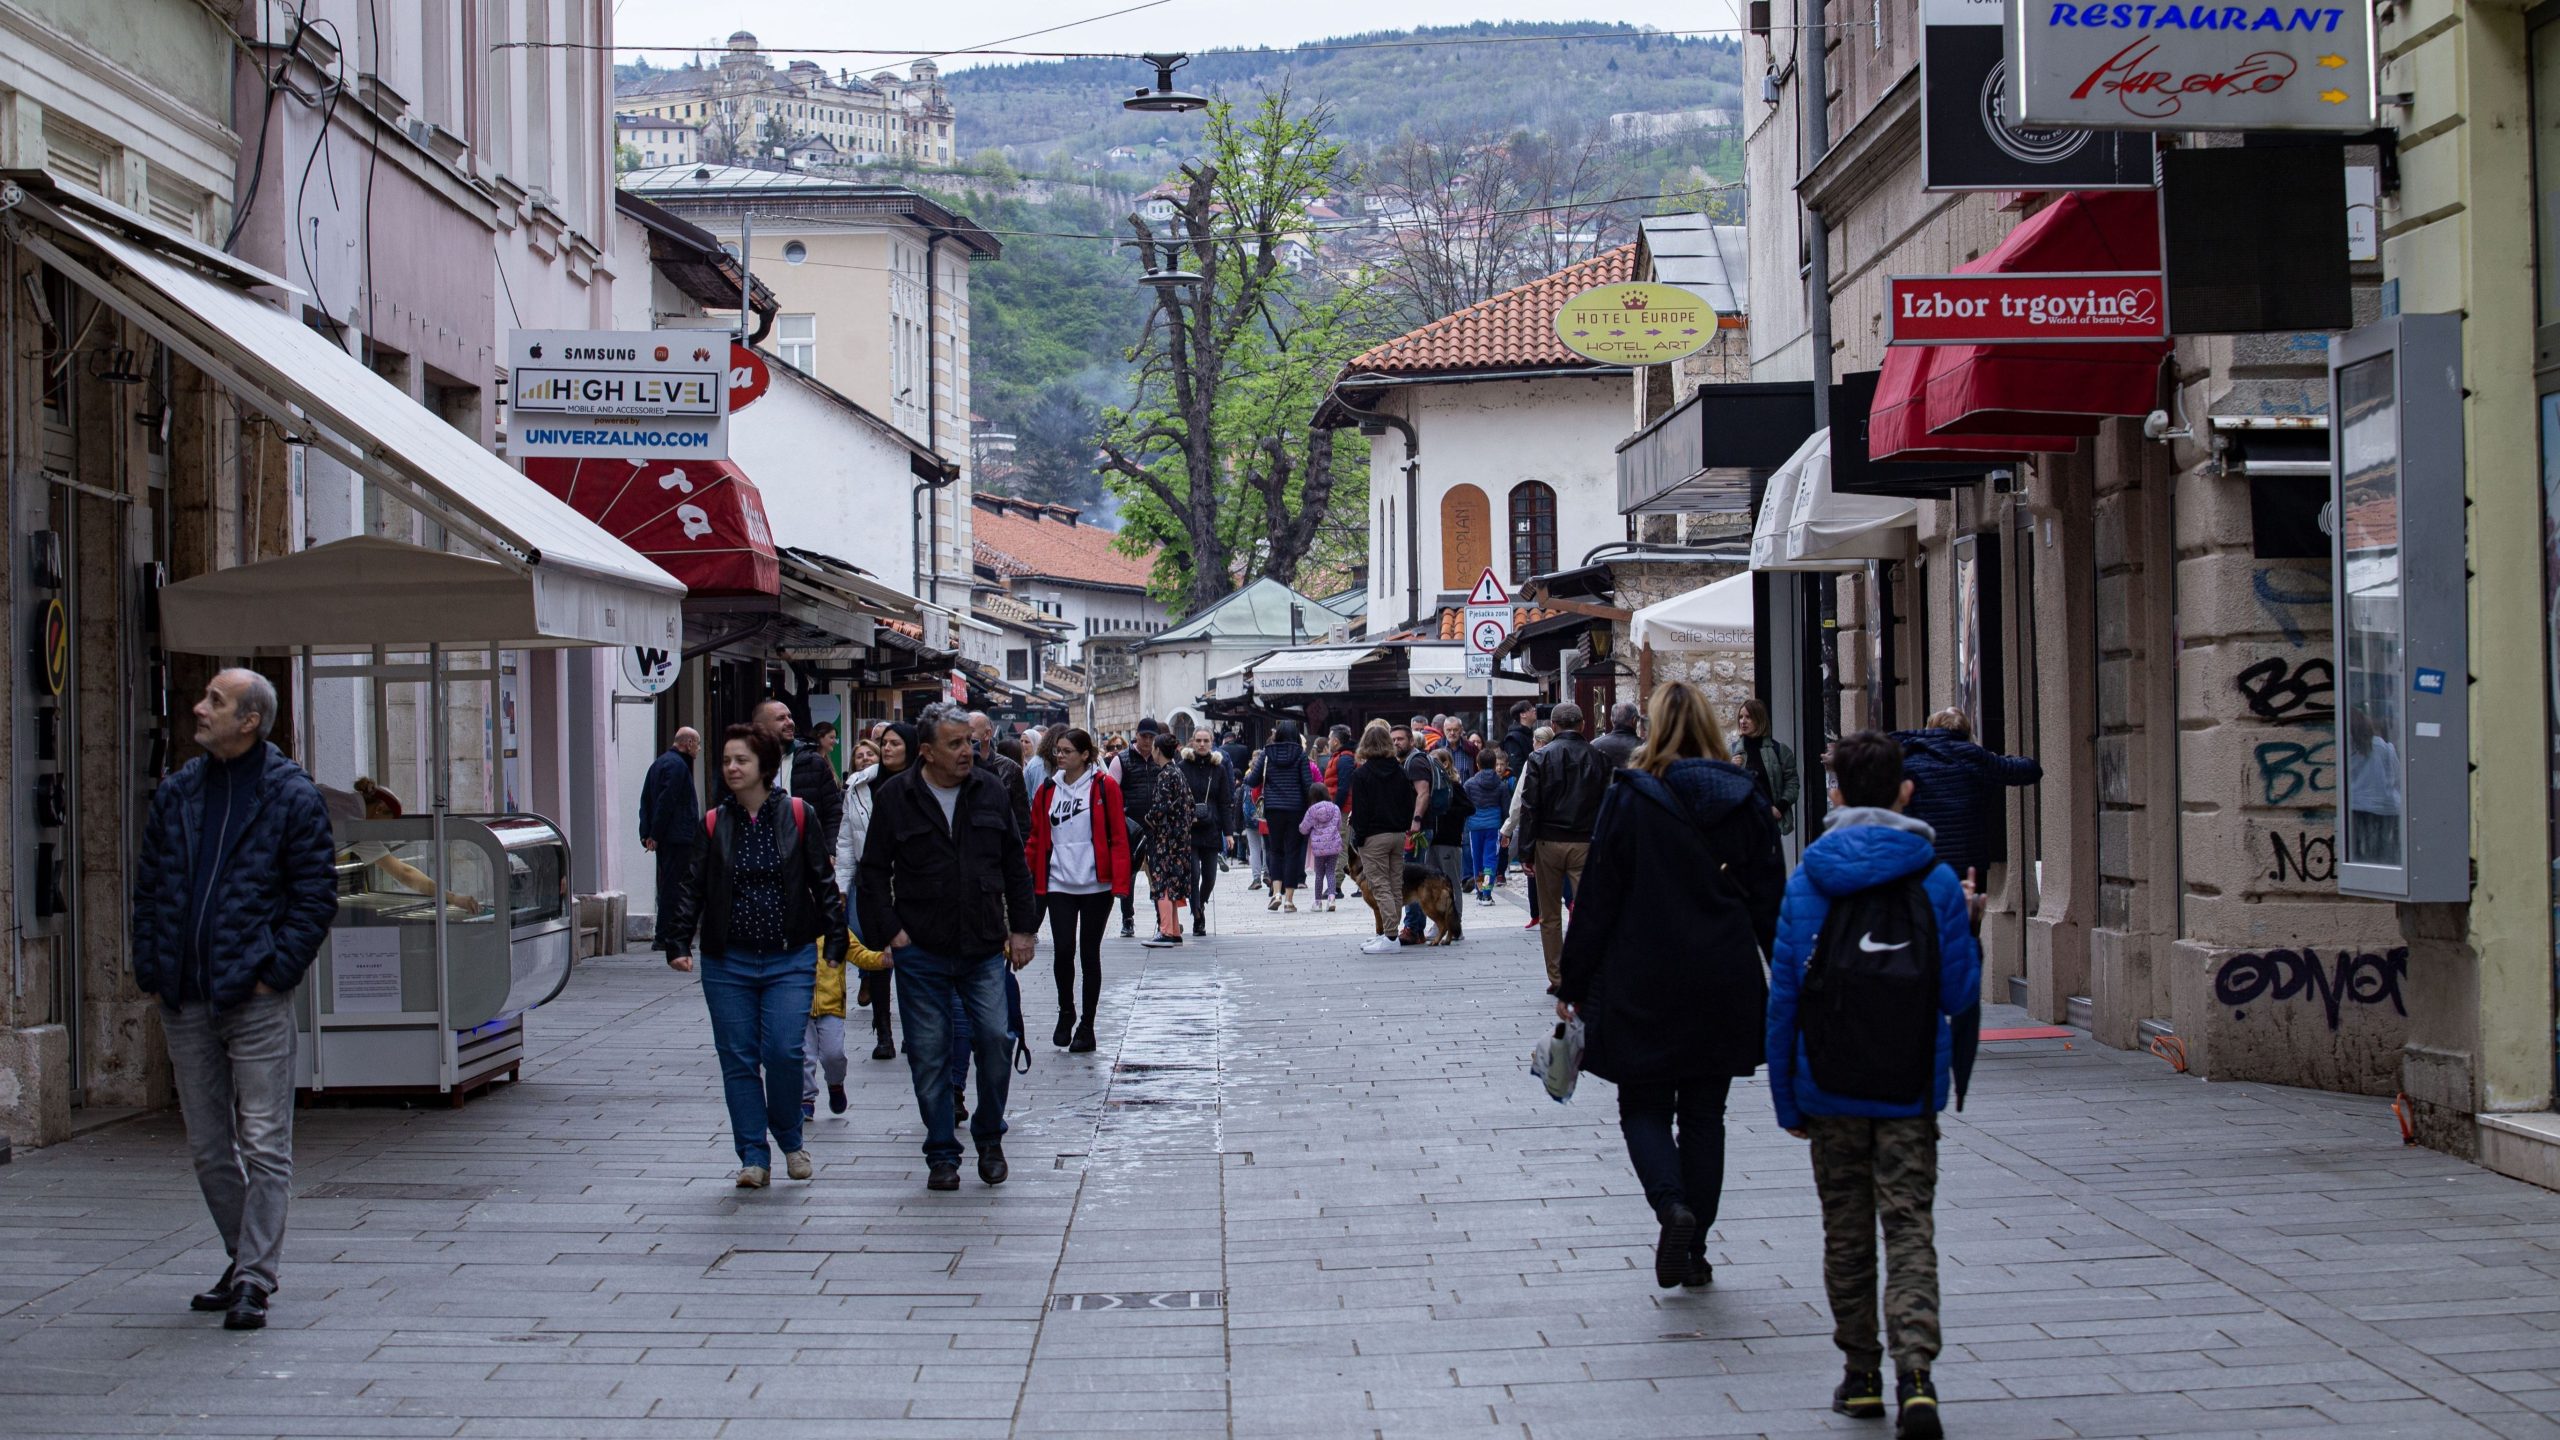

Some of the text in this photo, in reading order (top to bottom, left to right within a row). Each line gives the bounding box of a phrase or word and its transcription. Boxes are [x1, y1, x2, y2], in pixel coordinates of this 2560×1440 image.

[2049, 3, 2344, 33] RESTAURANT
[1902, 290, 2137, 324] Izbor trgovine
[2048, 315, 2126, 326] World of beauty
[1586, 340, 1690, 351] HOTEL ART
[565, 347, 636, 361] SAMSUNG
[553, 378, 710, 404] HIGH LEVEL
[567, 404, 664, 415] MOBILE AND ACCESSORIES
[594, 417, 640, 426] powered by
[526, 429, 708, 448] UNIVERZALNO.COM
[1670, 628, 1702, 643] caffe
[1261, 678, 1285, 688] SLATKO
[1424, 676, 1463, 695] OAZA
